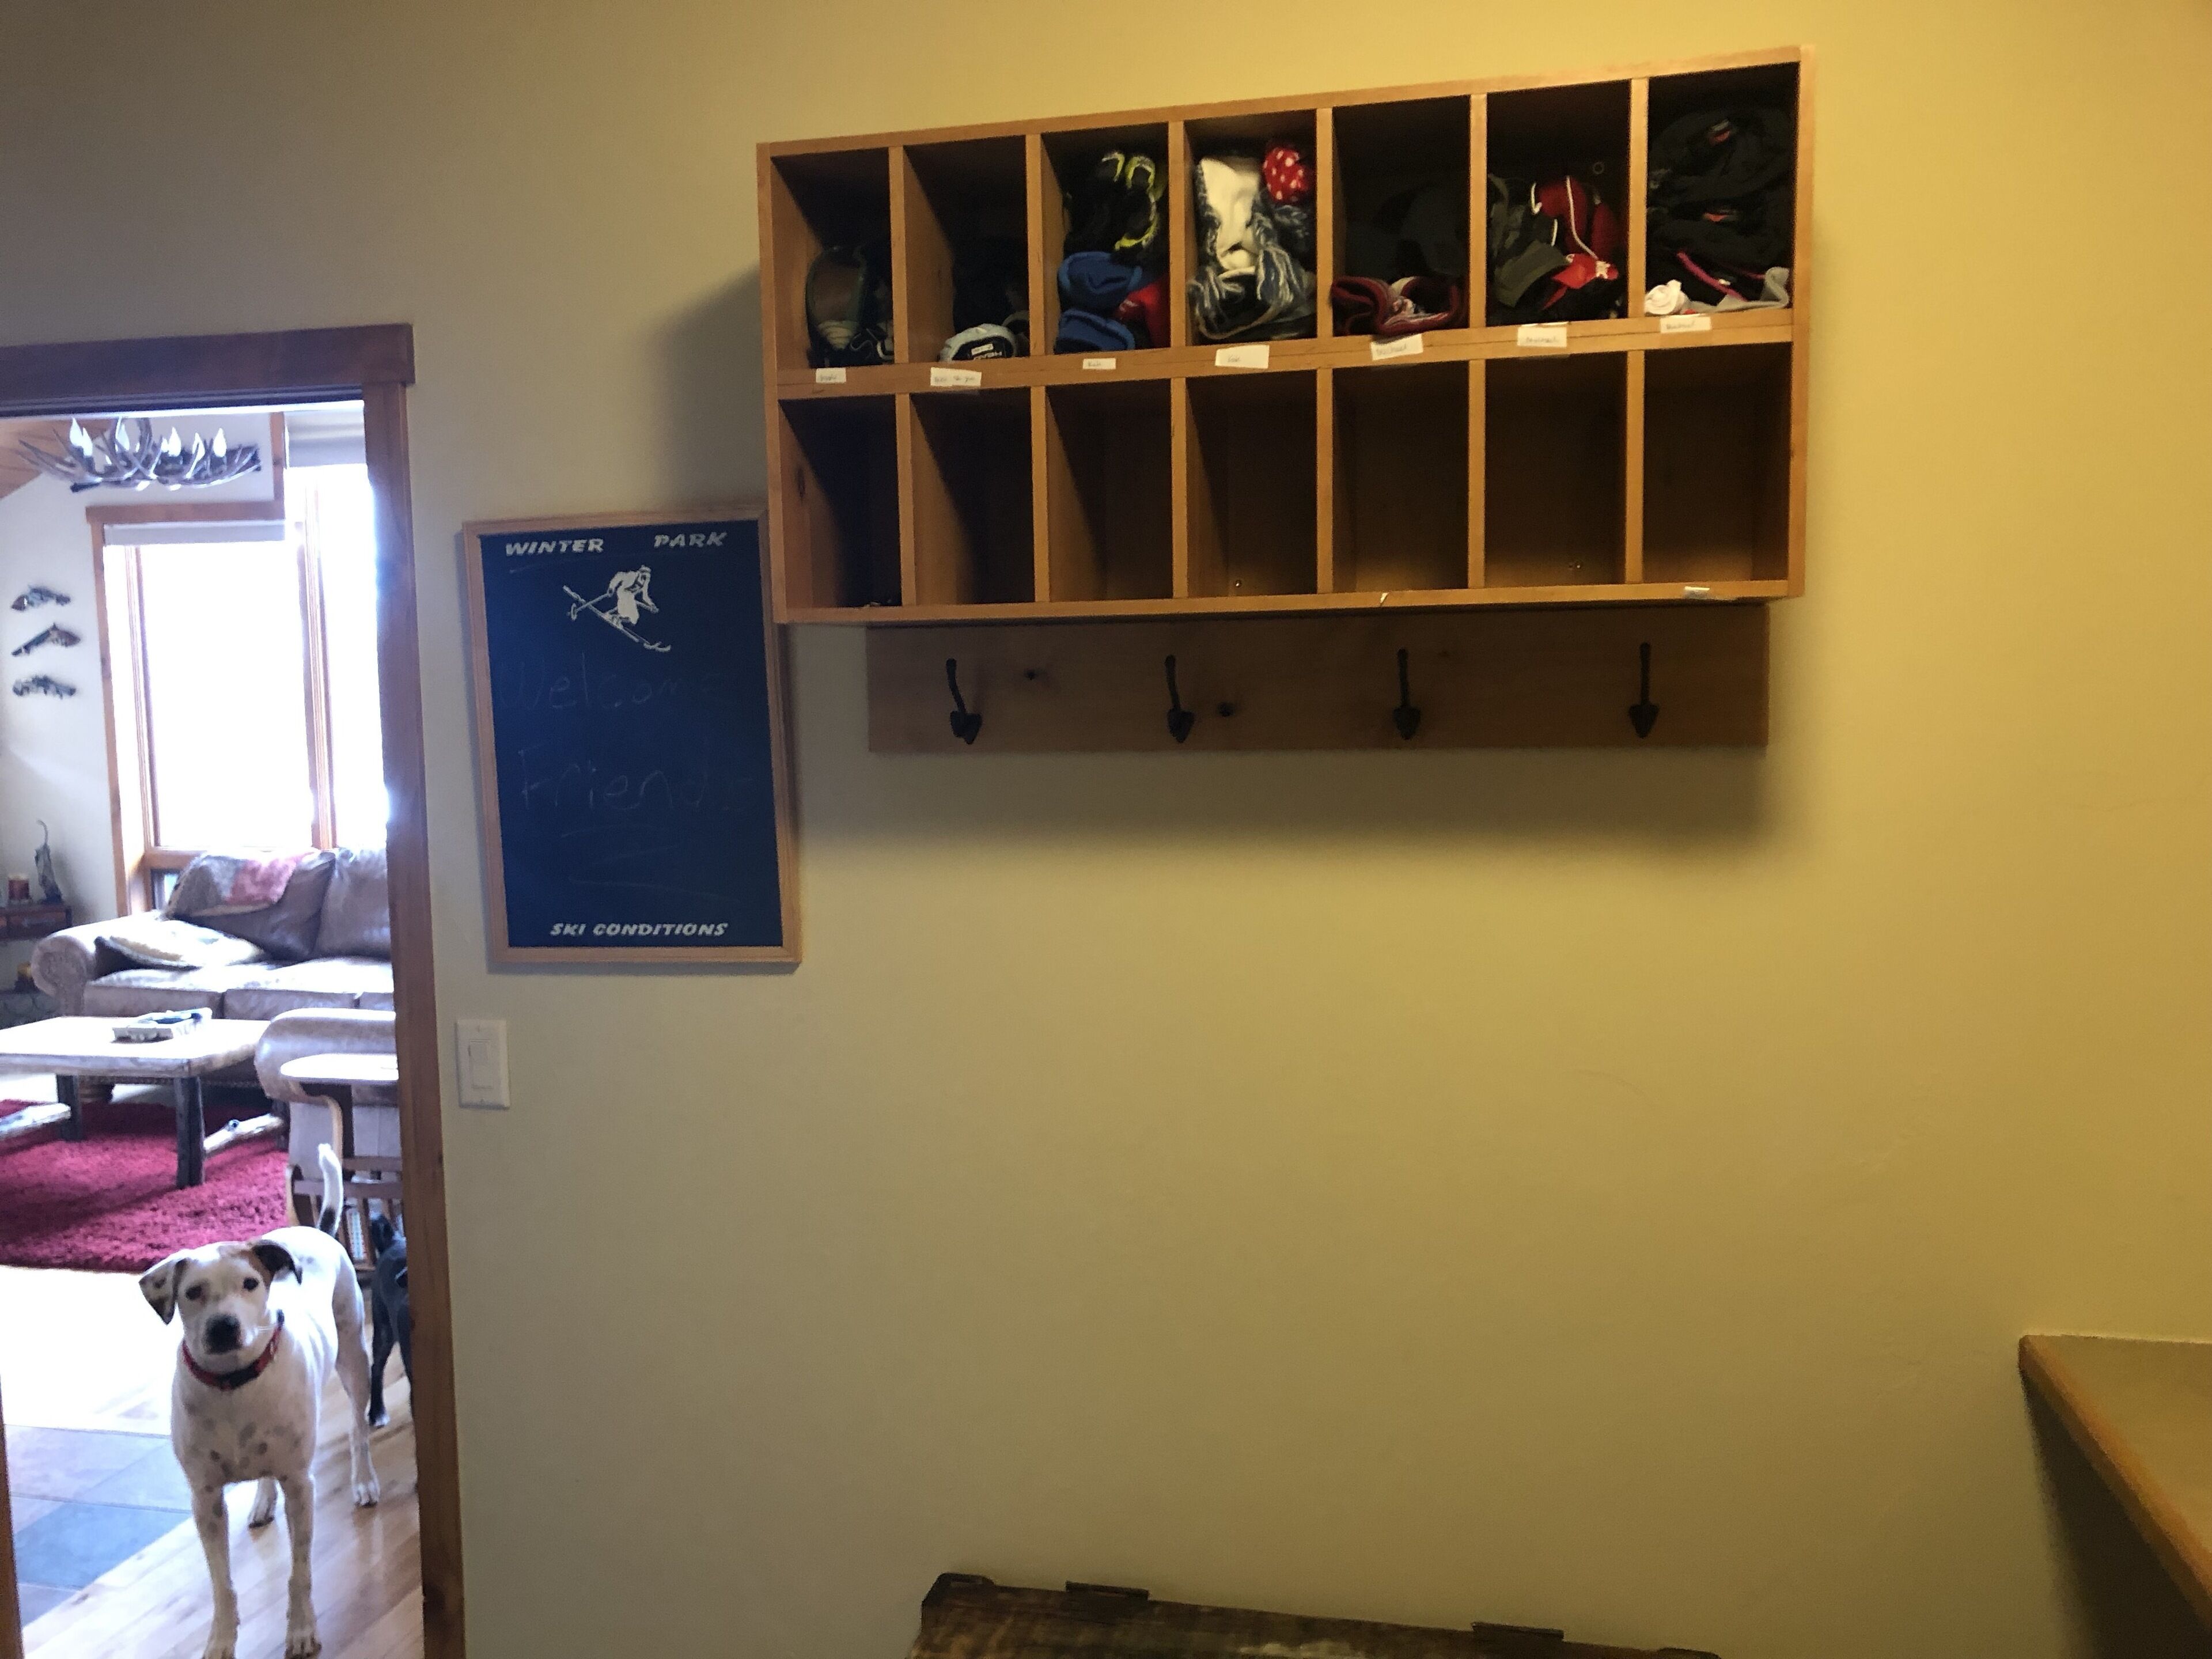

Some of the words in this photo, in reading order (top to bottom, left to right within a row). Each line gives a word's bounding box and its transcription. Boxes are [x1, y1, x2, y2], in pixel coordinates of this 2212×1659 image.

[505, 538, 604, 556] WINTER
[653, 532, 727, 548] PARK
[550, 923, 586, 936] SKI
[592, 923, 728, 936] CONDITIONS
